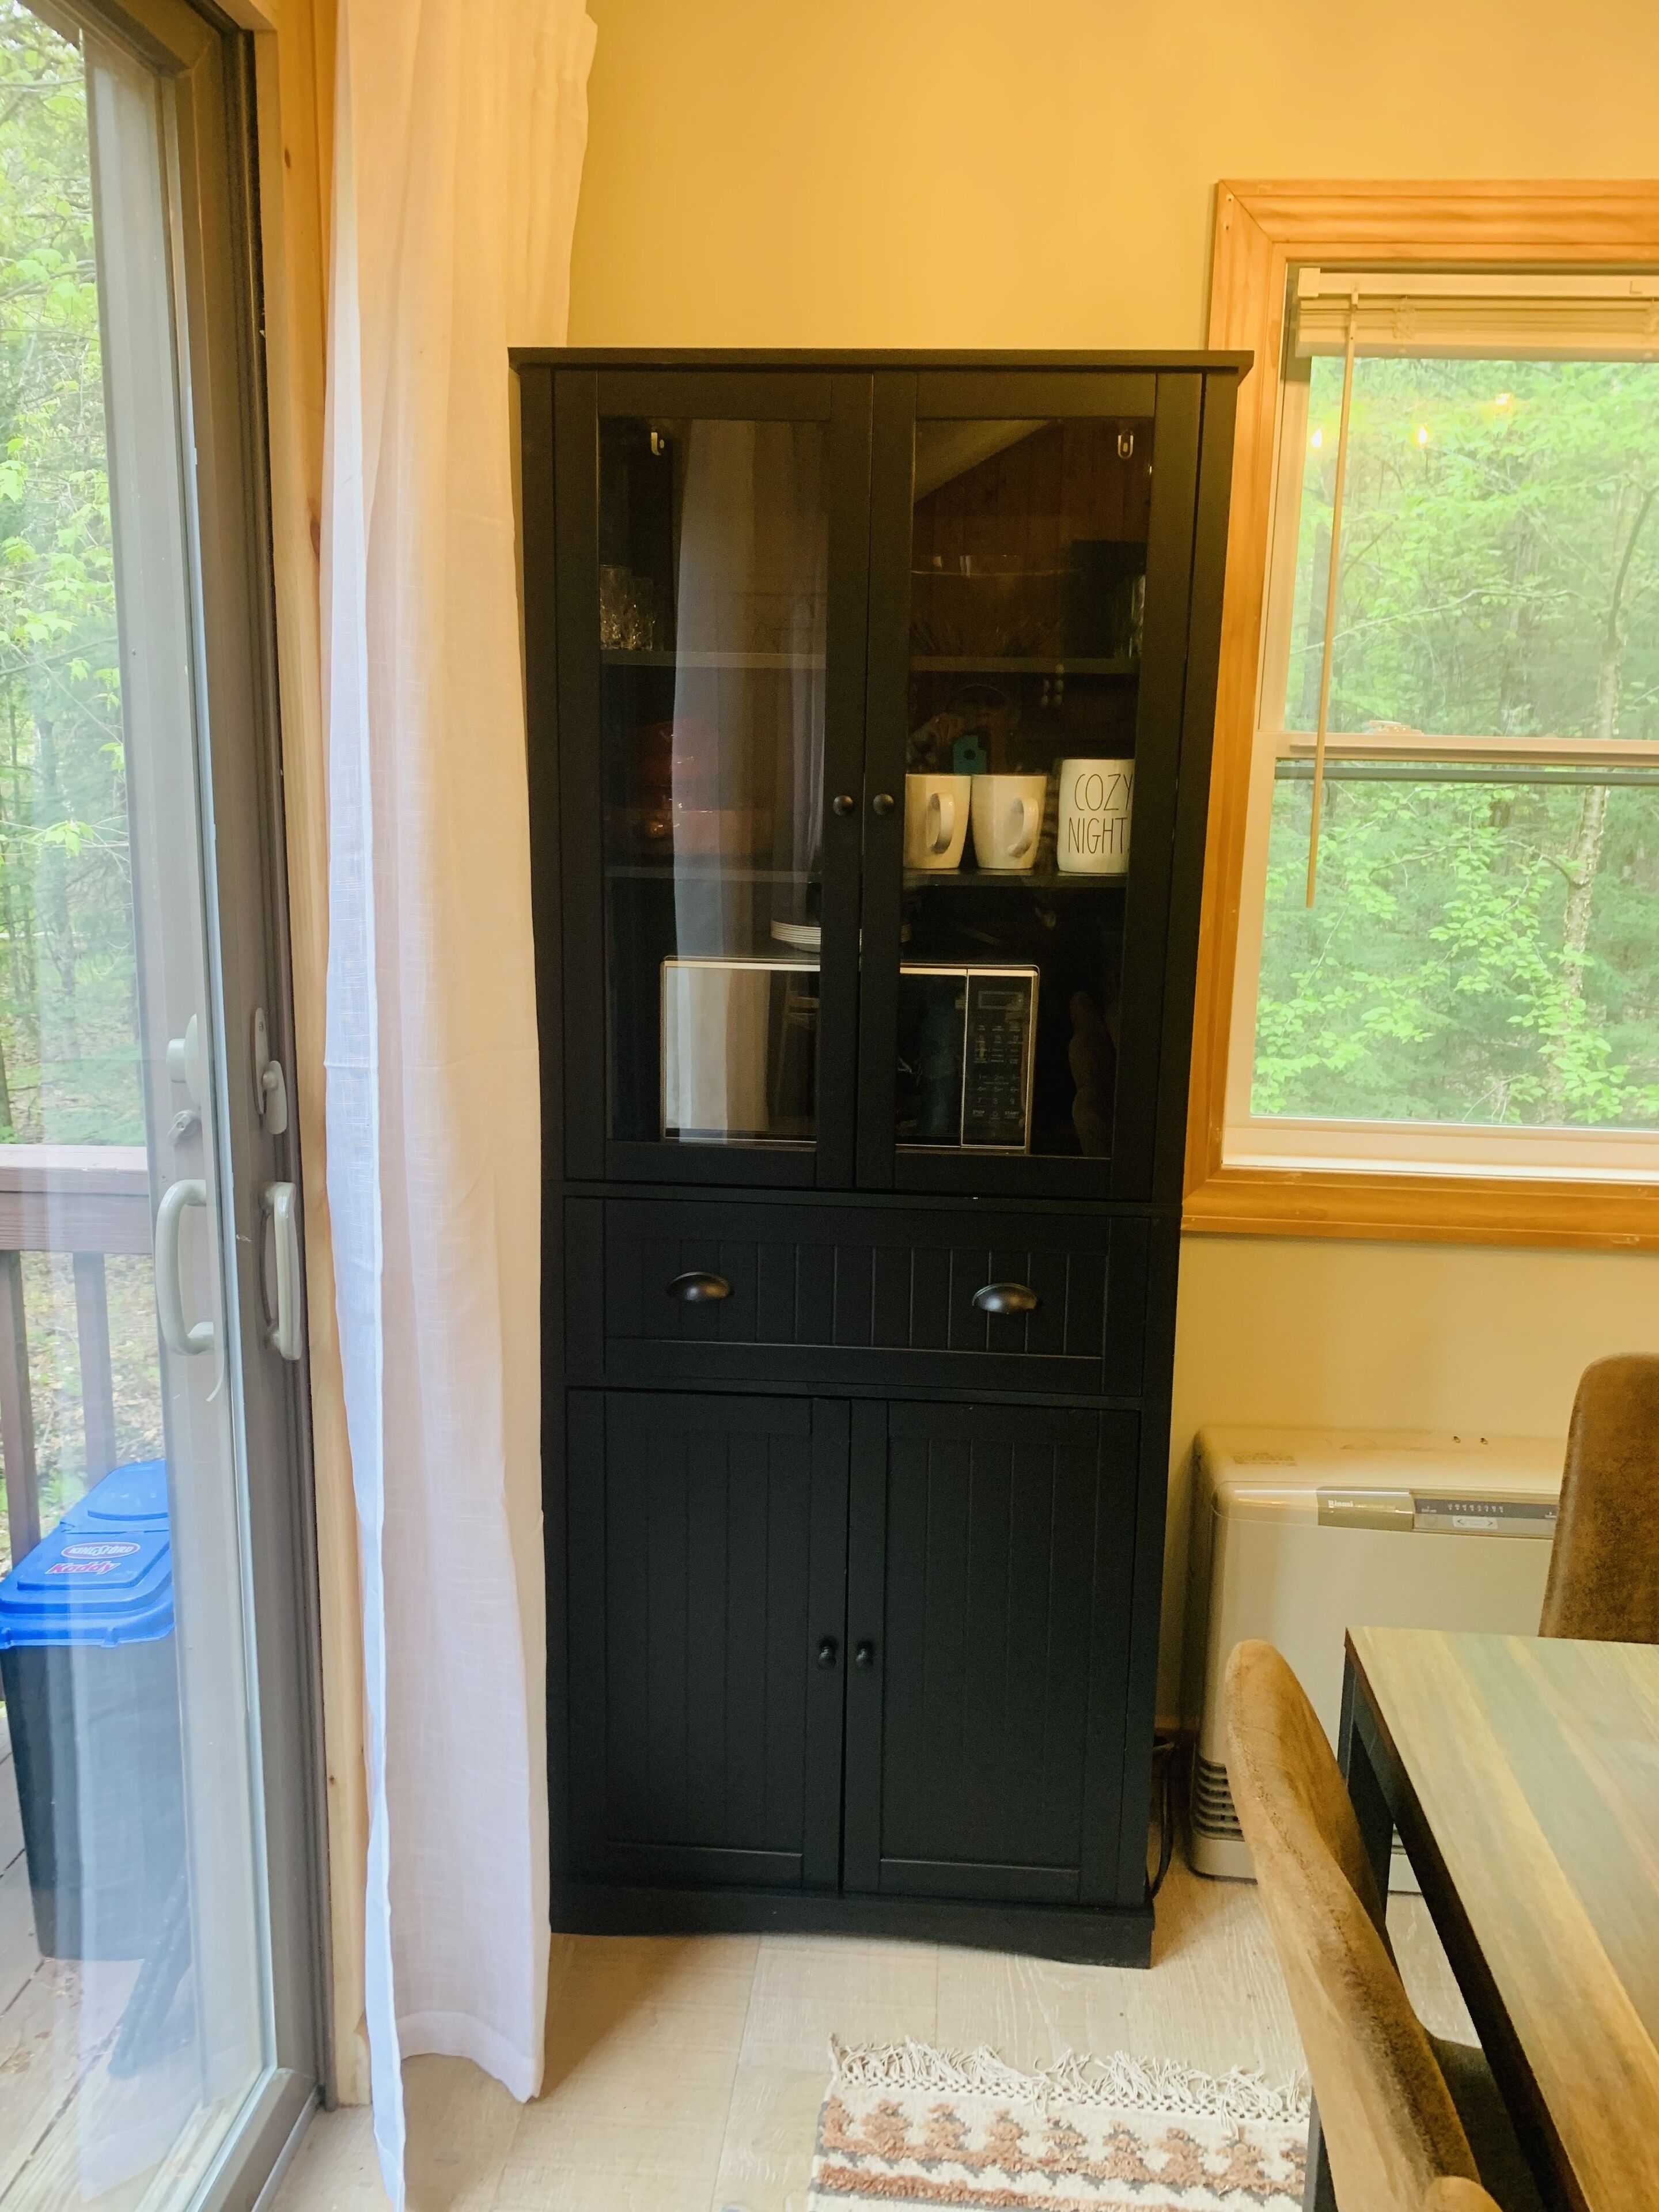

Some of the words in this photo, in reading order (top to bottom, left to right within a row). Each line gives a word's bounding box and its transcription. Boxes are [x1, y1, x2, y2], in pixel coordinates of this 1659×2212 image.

[1074, 774, 1133, 811] COZY
[1069, 817, 1130, 854] NIGHT
[68, 1546, 134, 1556] KINGSFORD
